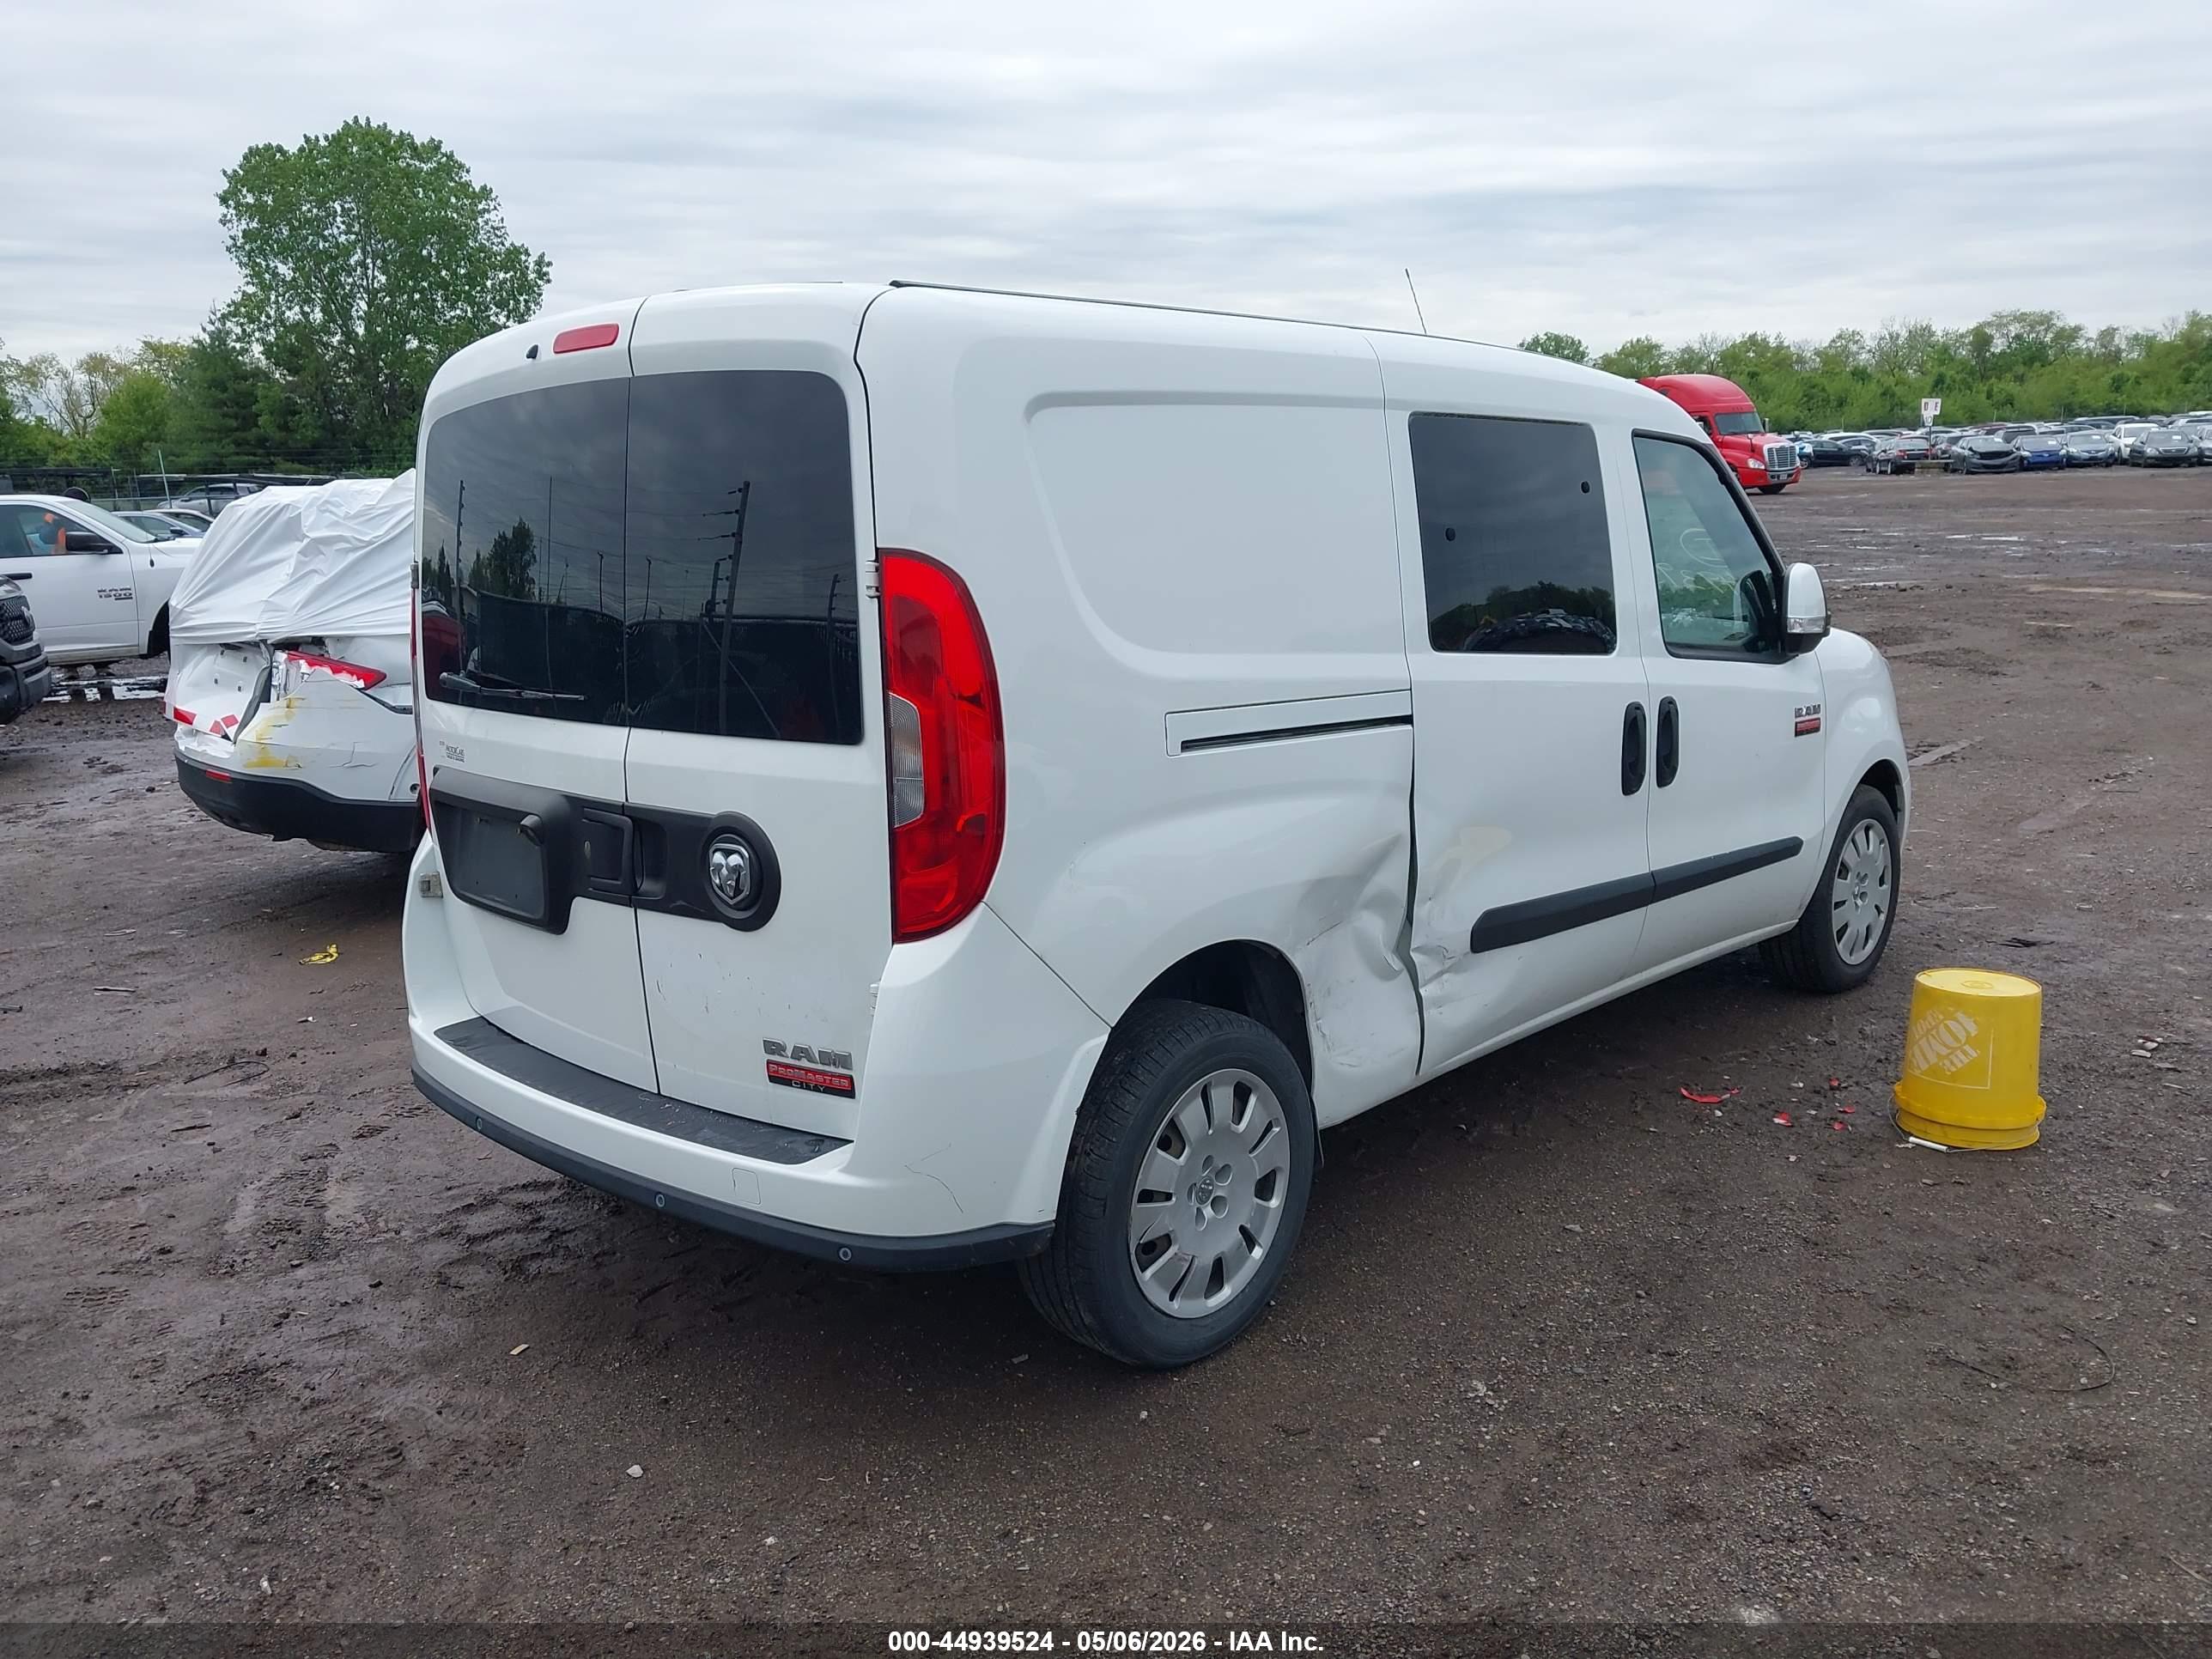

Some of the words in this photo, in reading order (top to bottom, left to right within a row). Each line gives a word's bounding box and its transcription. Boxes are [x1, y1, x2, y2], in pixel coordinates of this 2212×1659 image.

[1794, 703, 1821, 719] RAM
[762, 1036, 854, 1070] RAM
[768, 1063, 851, 1087] PROMASTER
[792, 1080, 825, 1092] CITY
